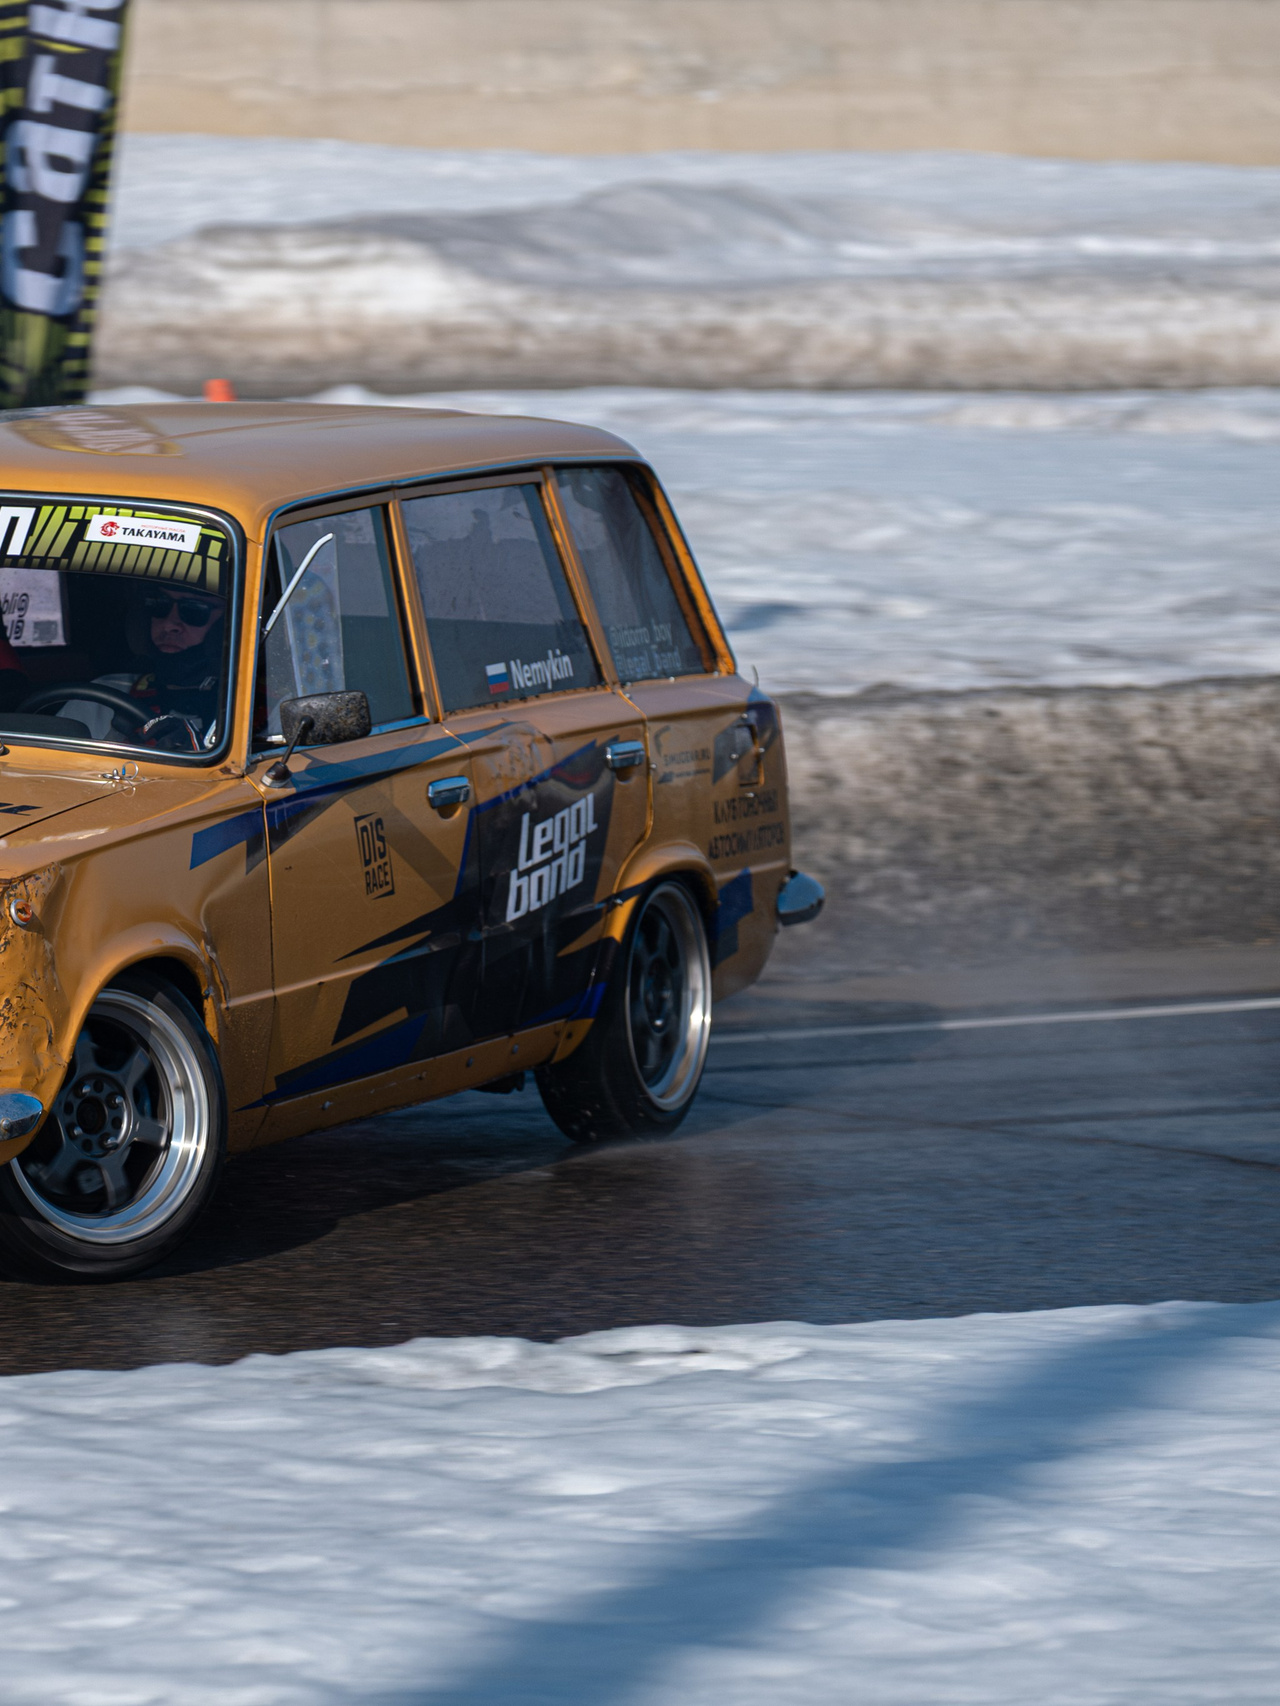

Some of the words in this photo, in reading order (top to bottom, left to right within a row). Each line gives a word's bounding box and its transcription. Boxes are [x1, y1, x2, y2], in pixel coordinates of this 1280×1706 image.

[122, 527, 186, 543] TAKAYAMA
[509, 648, 574, 690] Nemykin
[359, 817, 388, 868] DIS
[517, 792, 598, 872] Legal
[365, 861, 391, 896] RACE
